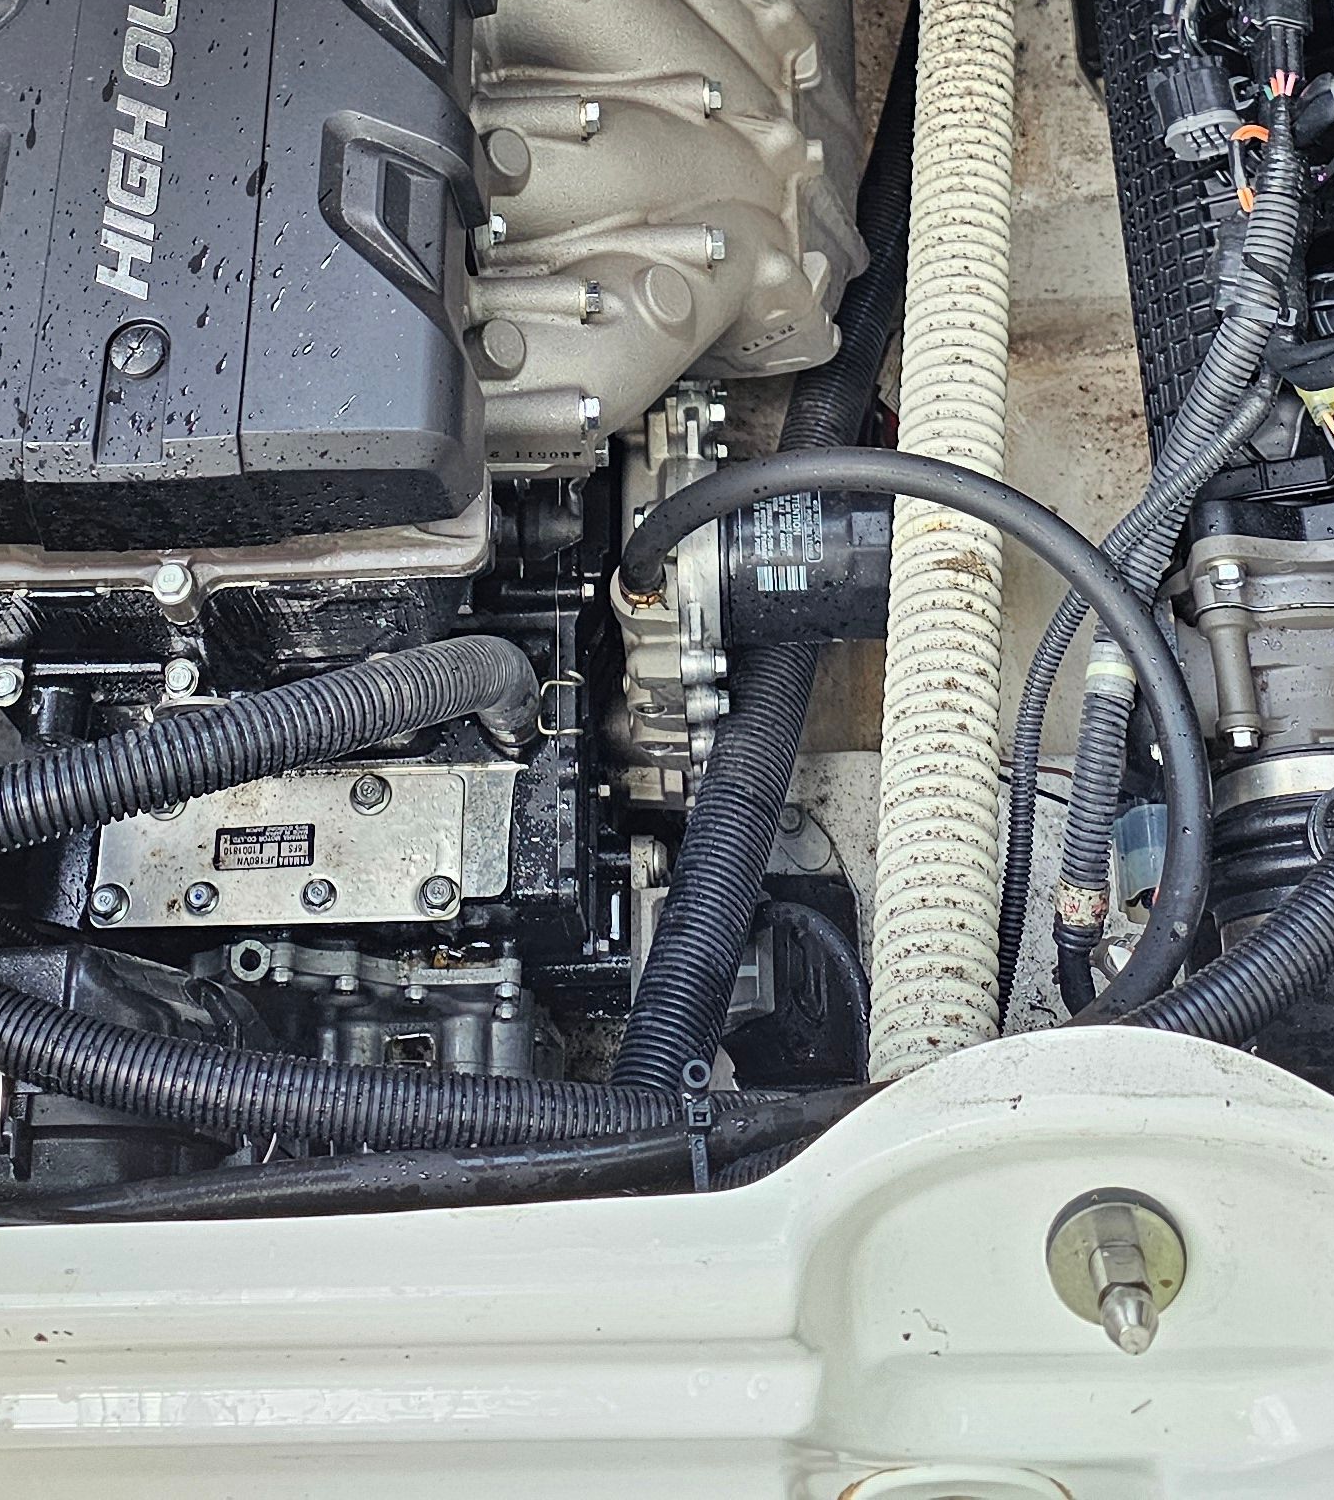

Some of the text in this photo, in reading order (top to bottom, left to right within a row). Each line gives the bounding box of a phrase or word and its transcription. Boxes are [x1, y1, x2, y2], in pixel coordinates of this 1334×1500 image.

[95, 93, 167, 300] HIGH
[791, 493, 801, 535] TTENTION
[257, 834, 281, 842] MOTOR
[282, 833, 307, 841] YAMAHA
[287, 843, 302, 853] 6FS
[278, 855, 309, 865] YAMAHA
